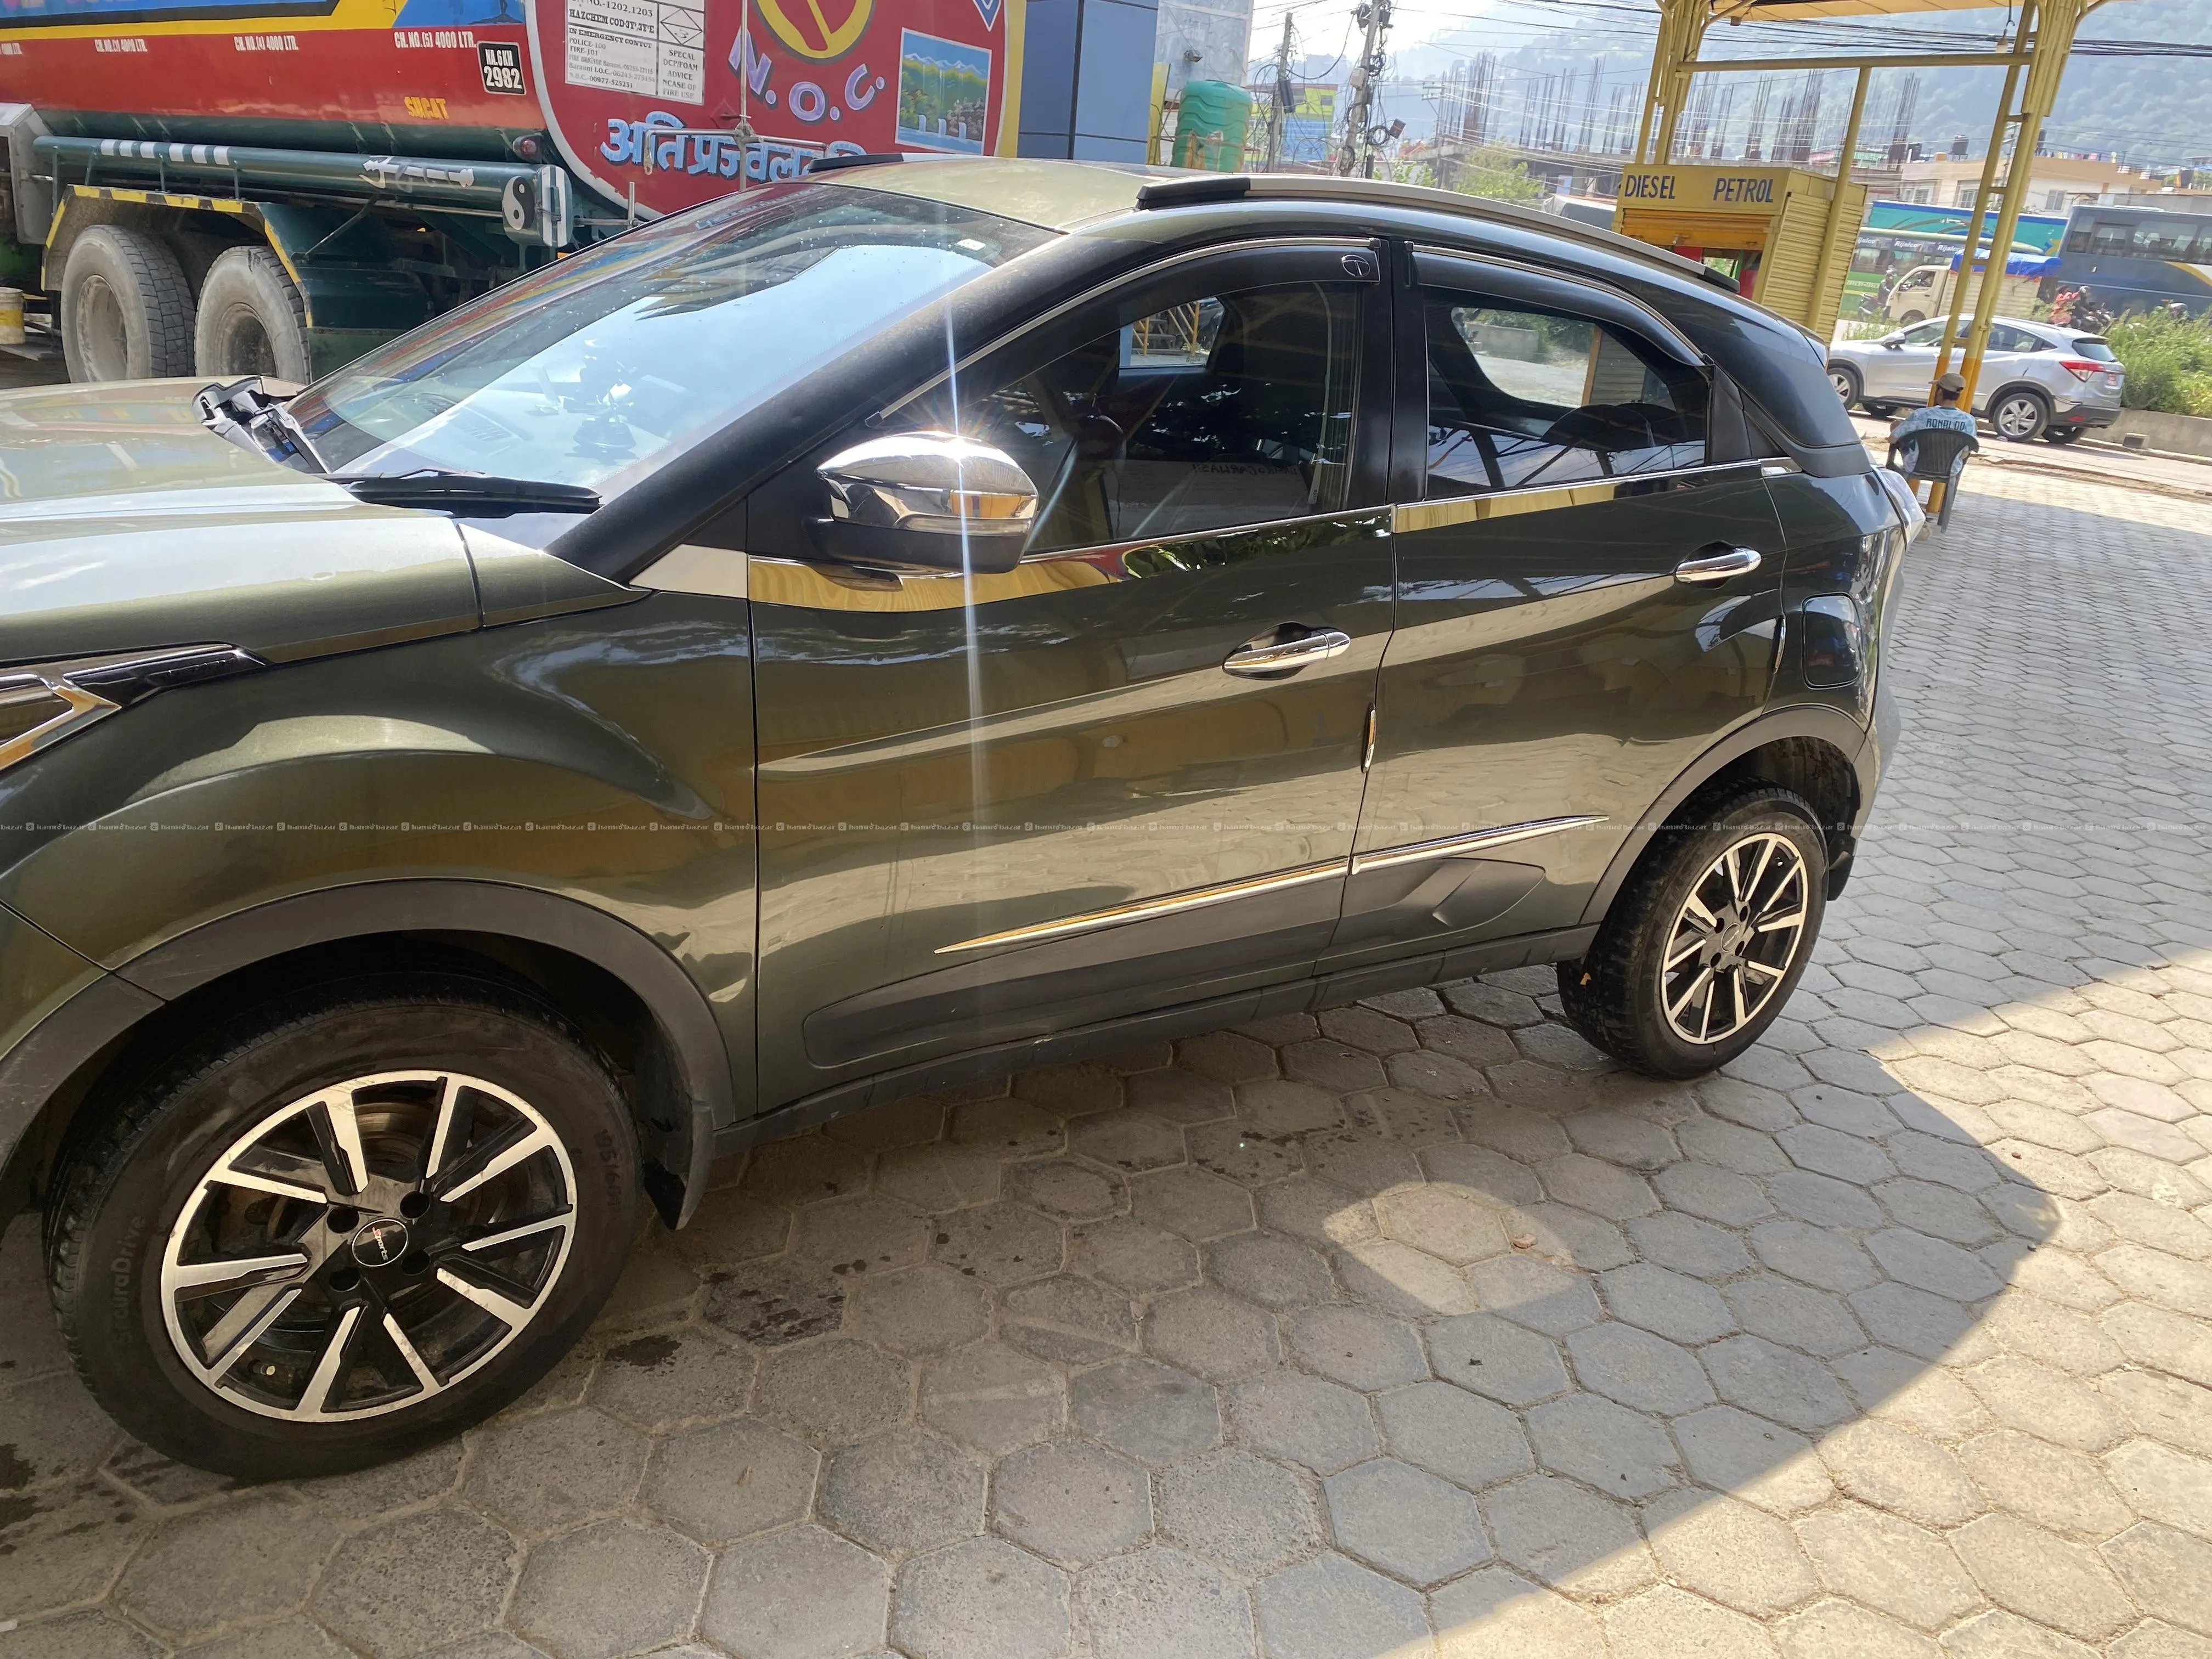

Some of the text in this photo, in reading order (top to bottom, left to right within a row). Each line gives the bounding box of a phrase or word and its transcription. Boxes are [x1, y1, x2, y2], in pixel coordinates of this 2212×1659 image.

[569, 8, 608, 24] HAZCHEM
[435, 31, 457, 48] 4000
[458, 31, 477, 48] LTR.
[578, 29, 623, 43] EMERGENCY
[669, 49, 695, 60] SPECAL
[483, 66, 522, 89] 2982
[667, 70, 693, 80] ADVICE
[663, 88, 695, 99] FIRE USE
[1624, 174, 1774, 203] DIESEL PETROL
[1926, 418, 1966, 431] RONALDO
[372, 1227, 388, 1260] Sports
